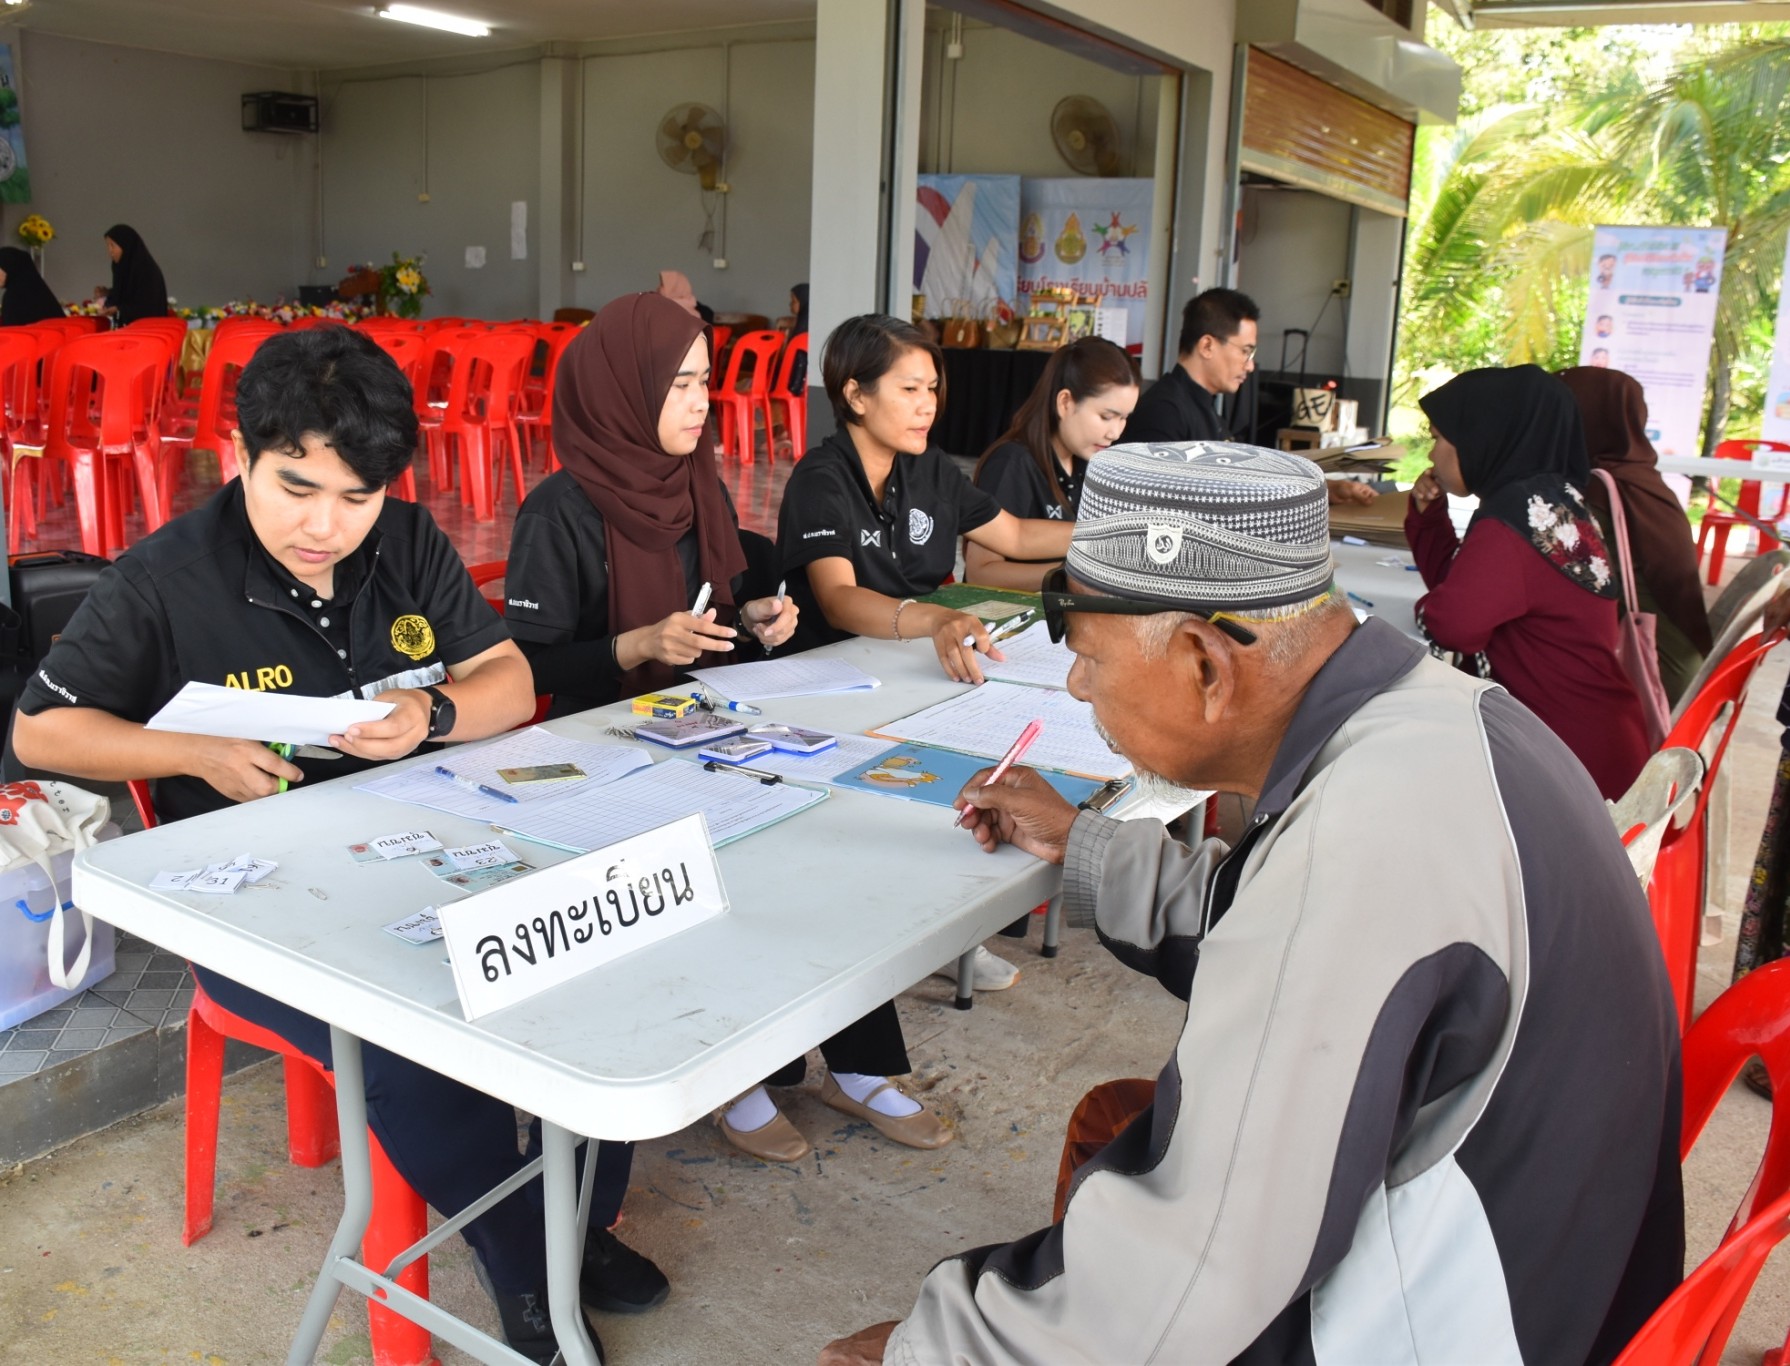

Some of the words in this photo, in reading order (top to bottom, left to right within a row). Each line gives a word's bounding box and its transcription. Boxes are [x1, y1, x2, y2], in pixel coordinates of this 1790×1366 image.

[225, 664, 293, 692] ALRO
[475, 858, 694, 983] ลงทะเบียน
